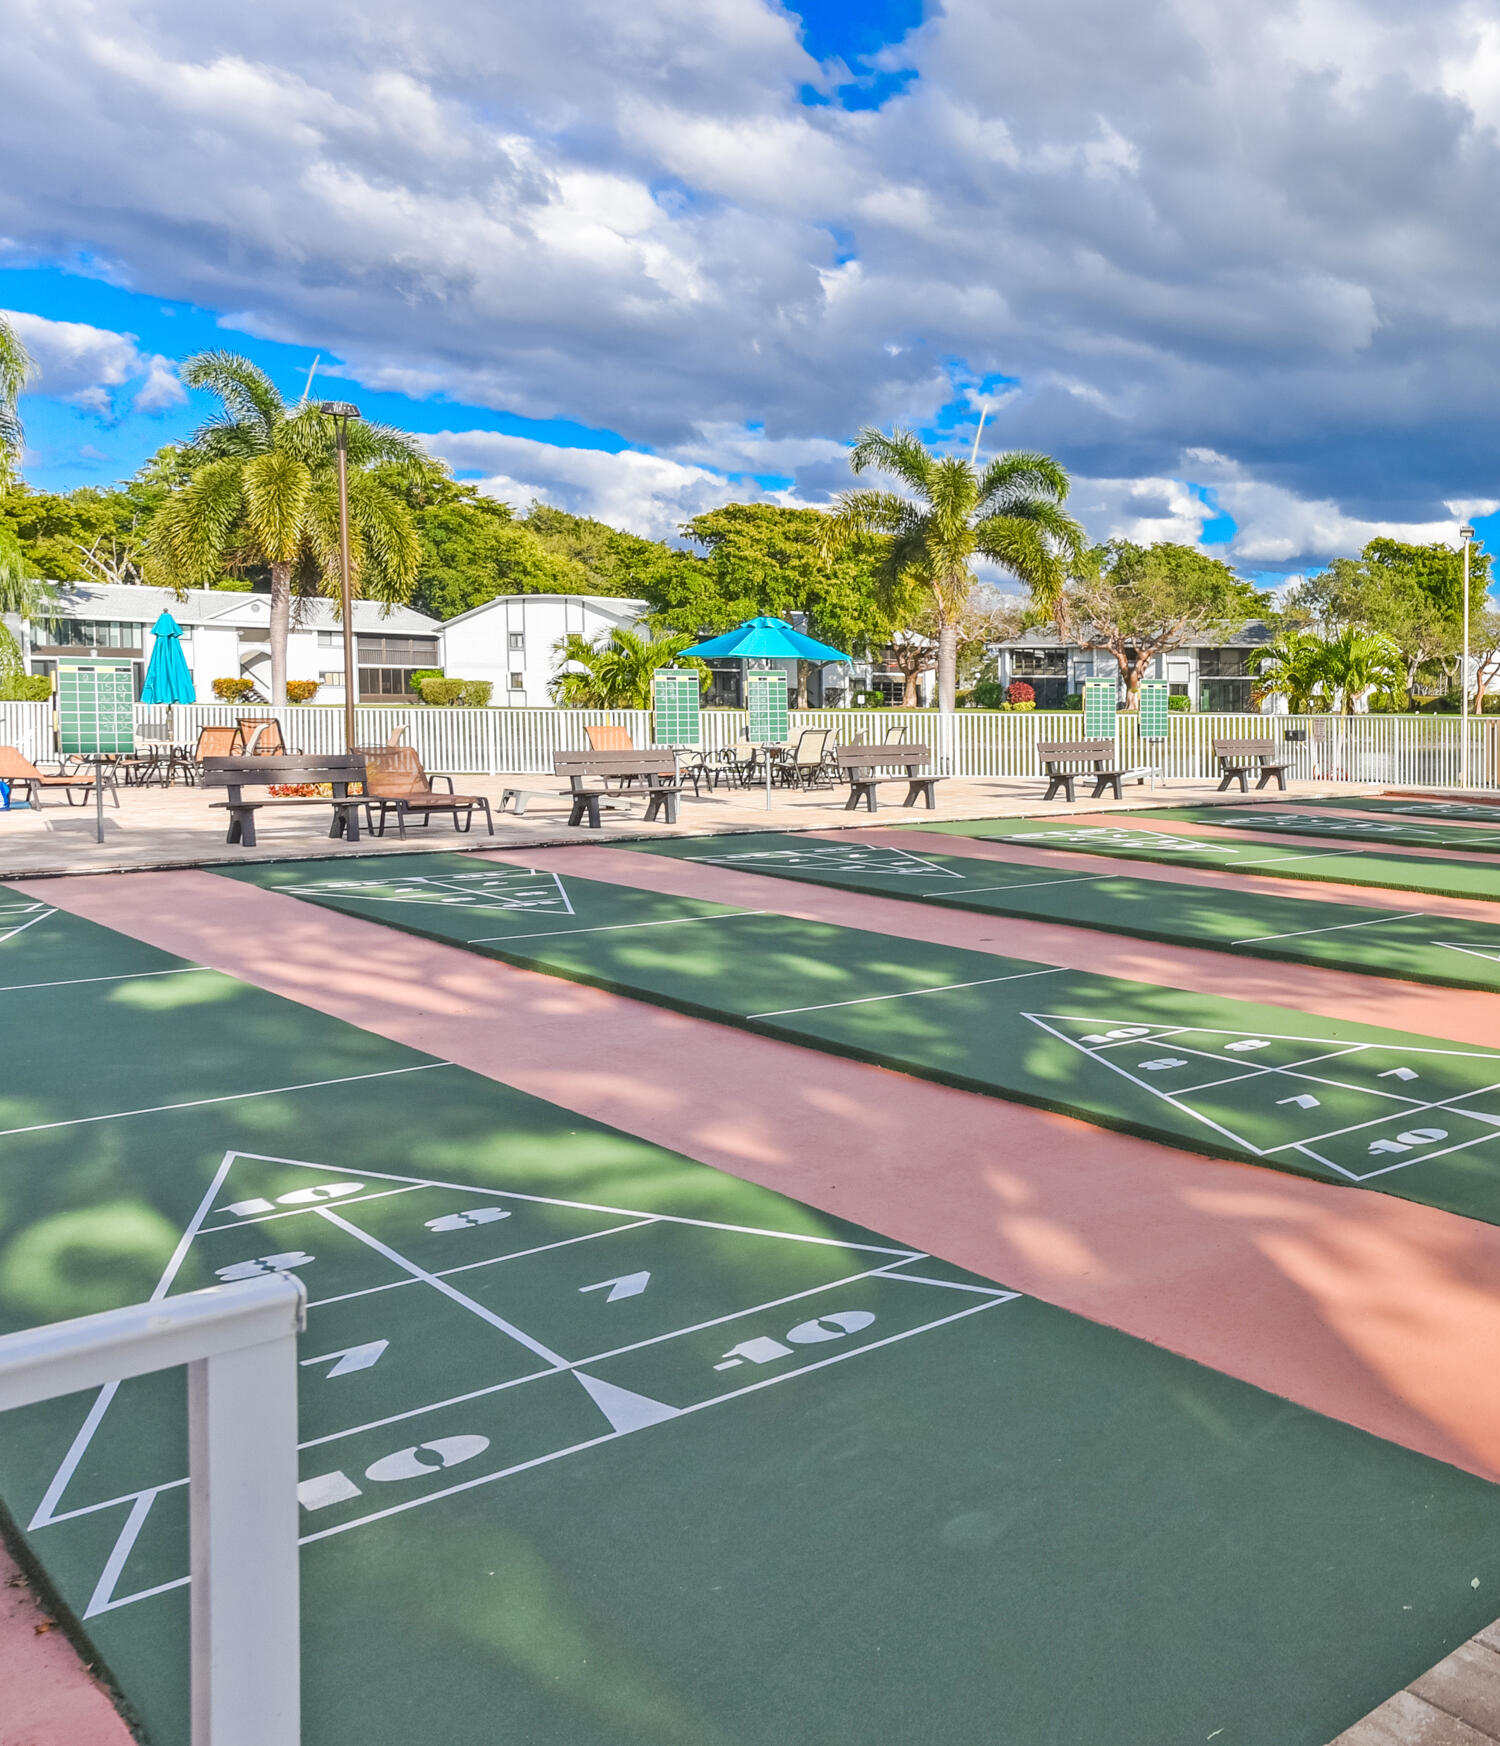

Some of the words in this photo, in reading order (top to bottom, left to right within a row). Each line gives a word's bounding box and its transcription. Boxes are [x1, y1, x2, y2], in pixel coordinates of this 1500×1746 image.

[1078, 1027, 1150, 1044] 10
[1223, 1038, 1272, 1052] 8
[1137, 1057, 1188, 1071] 8
[1367, 1128, 1449, 1155] 10
[214, 1182, 366, 1217] 10
[424, 1207, 512, 1233] 8
[214, 1251, 316, 1281] 8
[579, 1270, 651, 1303] 7
[713, 1311, 876, 1371] 10
[299, 1338, 390, 1379] 7
[297, 1434, 490, 1512] 10
